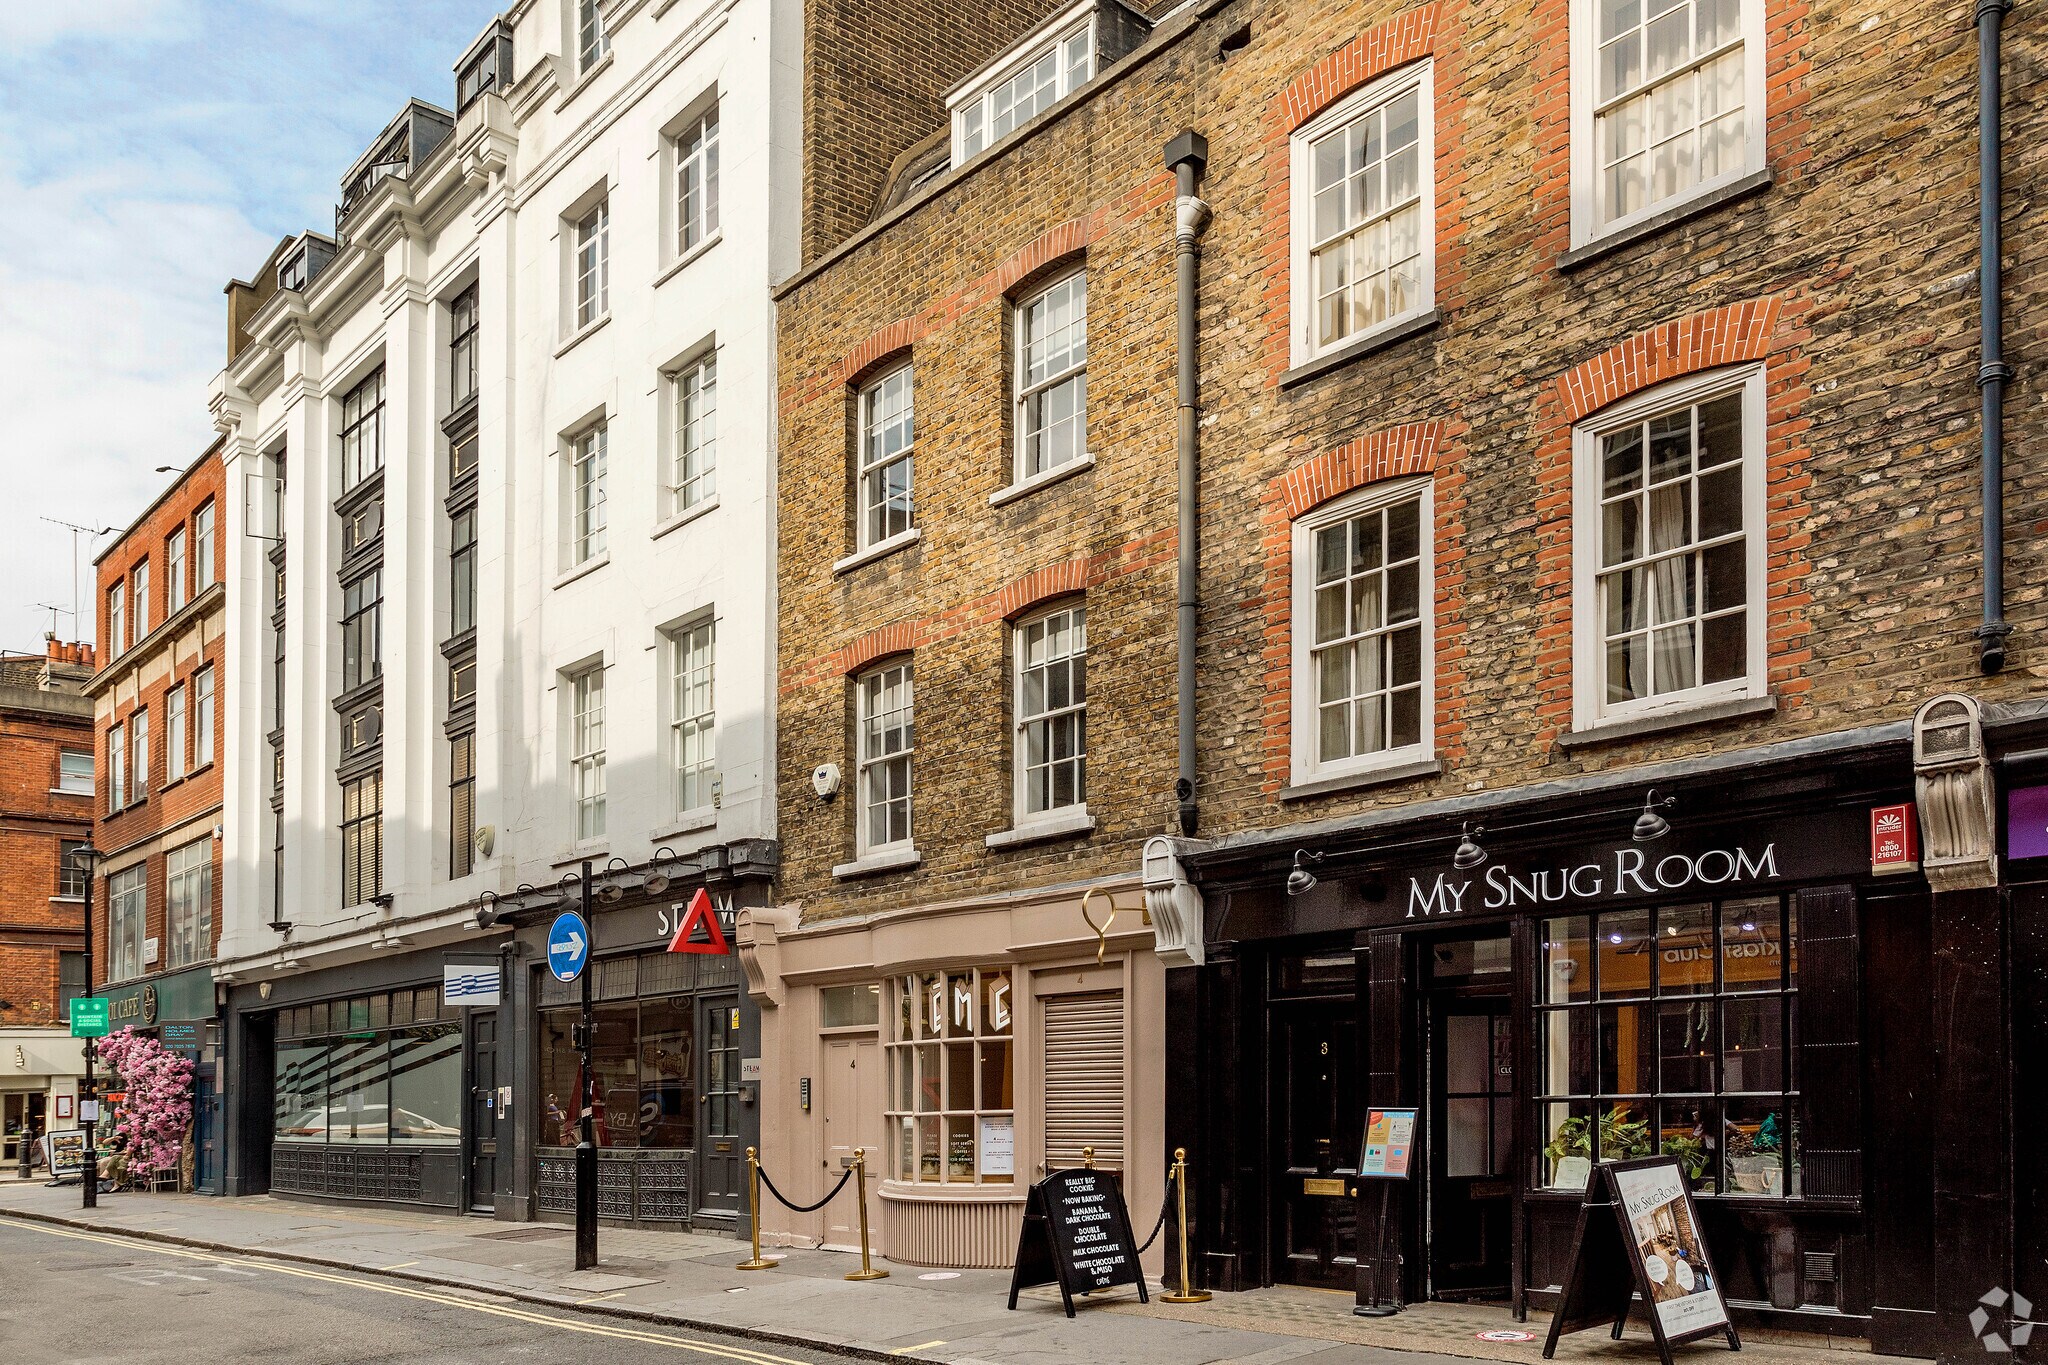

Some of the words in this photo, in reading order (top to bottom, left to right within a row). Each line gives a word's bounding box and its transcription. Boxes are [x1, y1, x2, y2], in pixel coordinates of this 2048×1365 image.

[1877, 849, 1902, 859] 216107
[1880, 844, 1899, 852] 0800
[1406, 872, 1473, 918] MY
[1484, 864, 1603, 909] SNUG
[1613, 842, 1781, 896] ROOM
[1077, 973, 1084, 985] 4
[118, 992, 140, 1019] CAFÉ
[1321, 1042, 1328, 1055] 3
[850, 1059, 856, 1070] 4
[1065, 1177, 1084, 1186] REALLY
[1084, 1176, 1095, 1184] BIG
[1069, 1185, 1094, 1193] COOKIES
[1628, 1200, 1642, 1216] MY
[1641, 1193, 1660, 1210] SNUG
[1657, 1184, 1681, 1200] ROOM
[1071, 1207, 1098, 1216] BANANA
[1098, 1205, 1104, 1213] &
[1065, 1216, 1081, 1225] DARK
[1081, 1212, 1111, 1222] CHOCOLATE
[1078, 1226, 1100, 1235] DOUBLE
[1074, 1232, 1107, 1244] CHOCOLATE
[1072, 1249, 1087, 1257] MILK
[1086, 1243, 1120, 1254] CHOCOLATE
[1073, 1260, 1092, 1269] WHITE
[1092, 1256, 1125, 1267] CHOCOLATE
